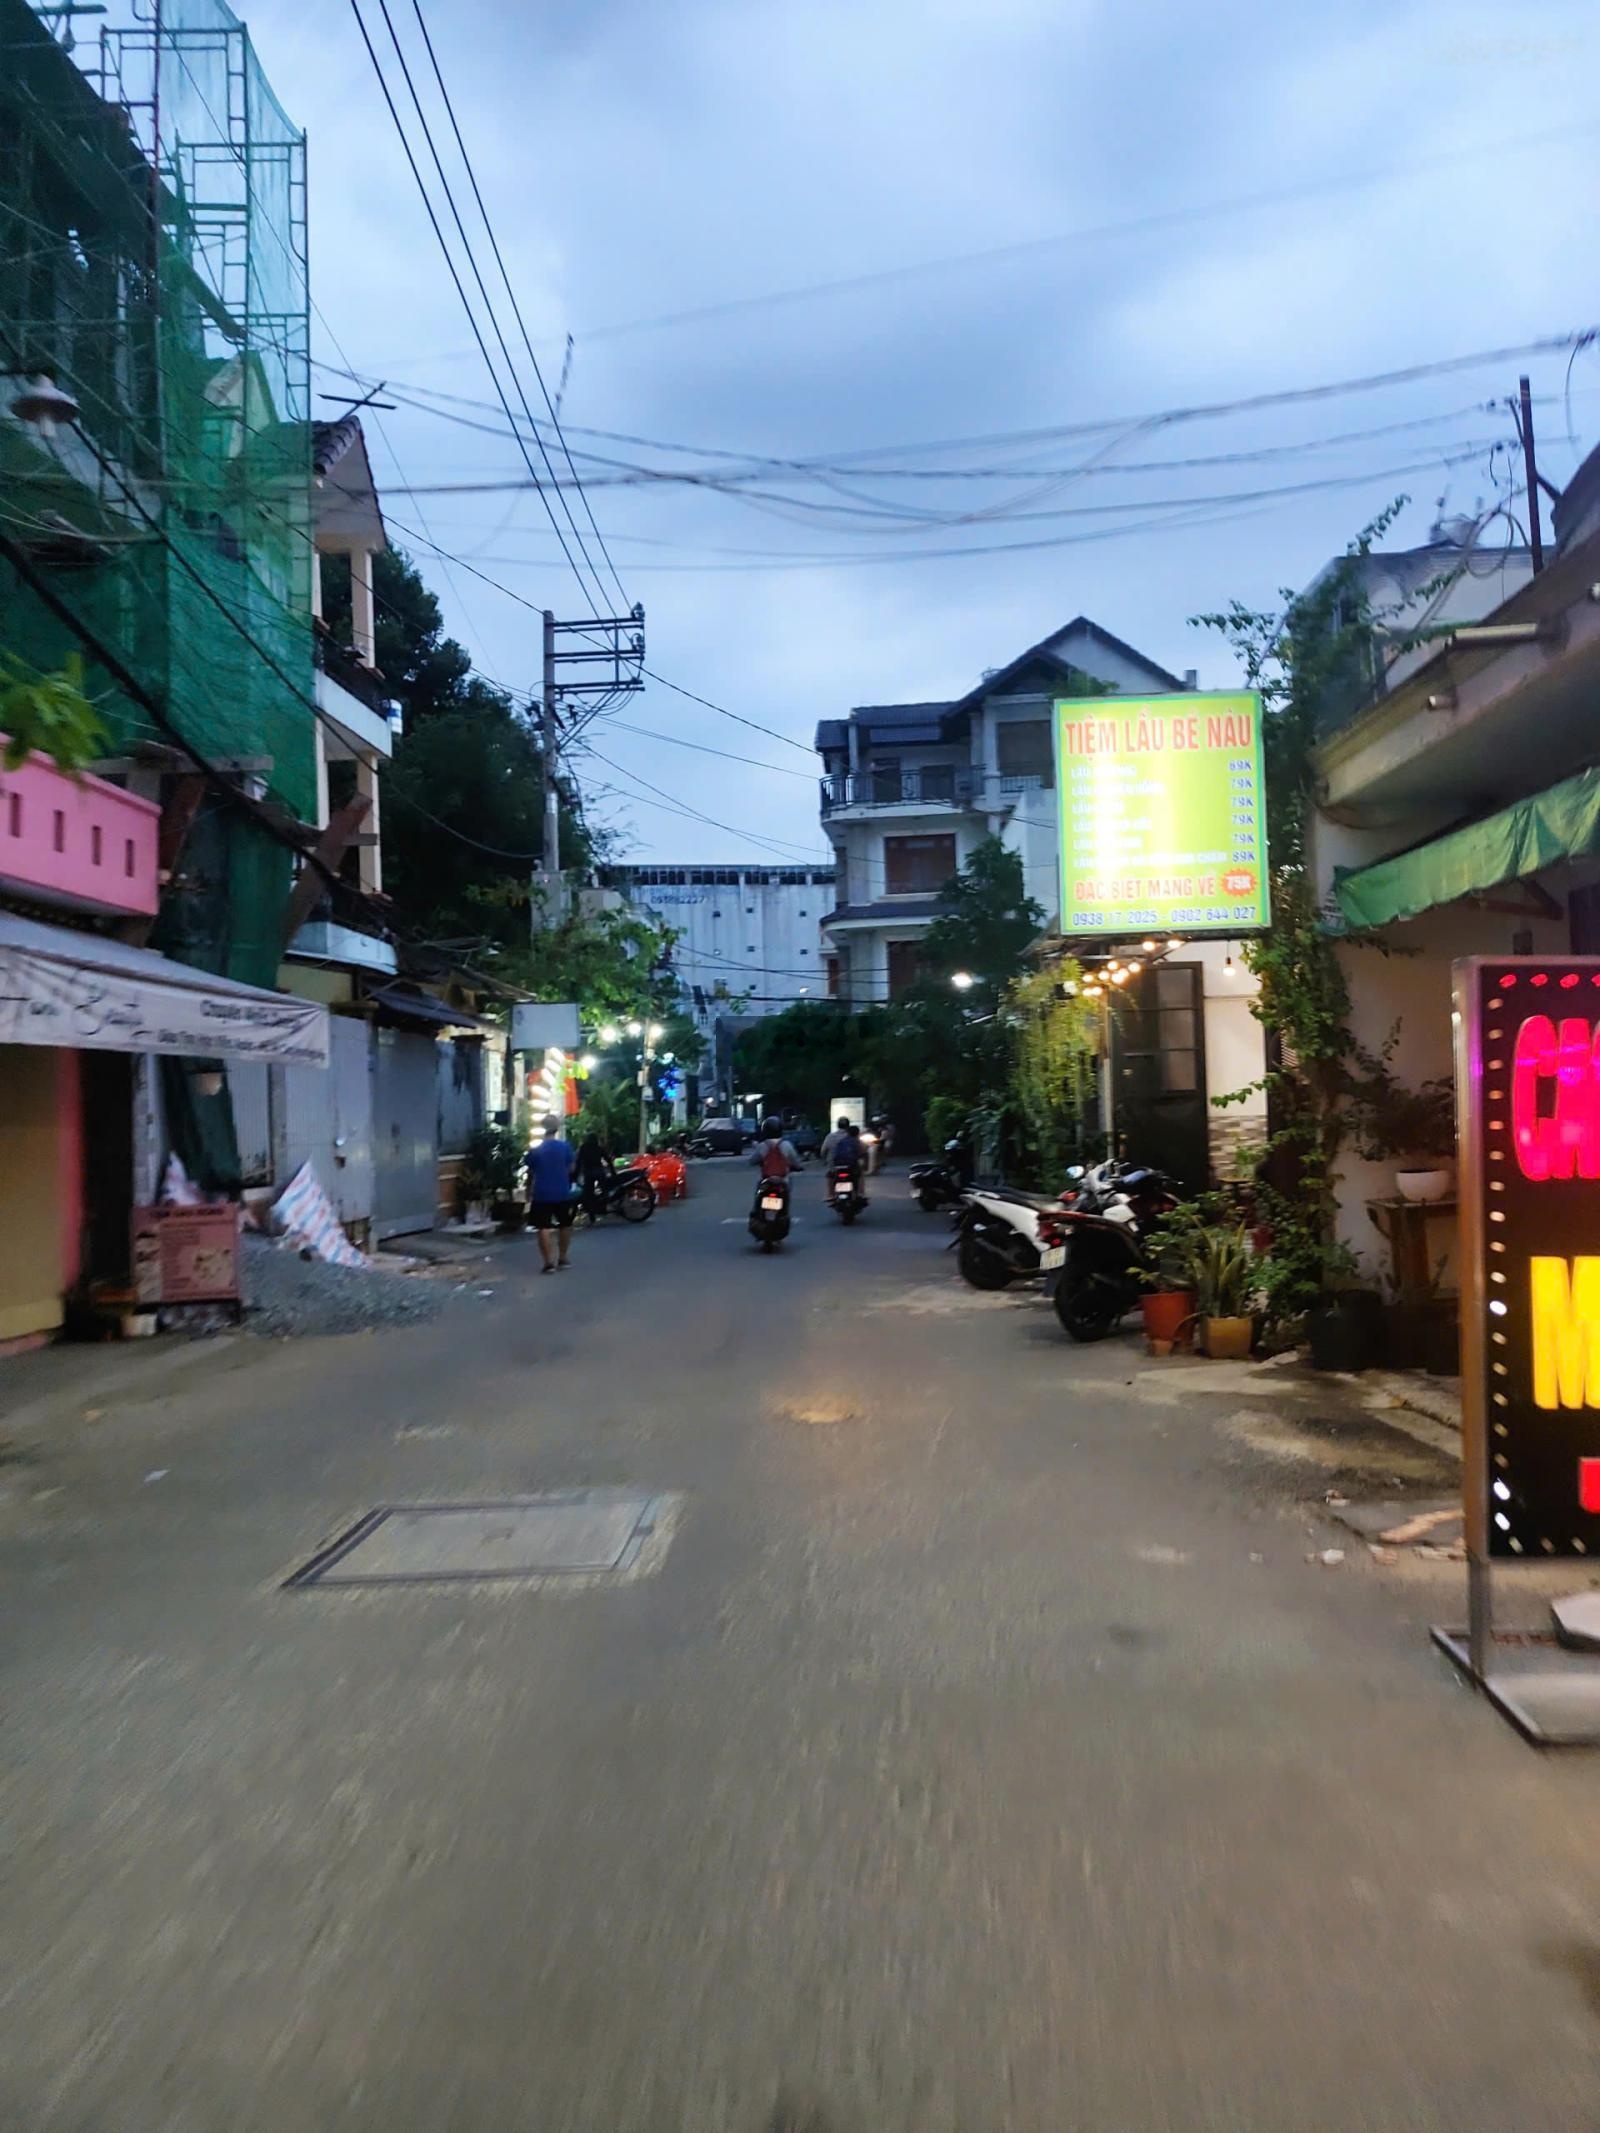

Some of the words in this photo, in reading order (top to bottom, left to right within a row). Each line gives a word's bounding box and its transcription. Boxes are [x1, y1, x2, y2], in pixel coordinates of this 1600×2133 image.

[1065, 714, 1117, 761] TIỆM
[1073, 912, 1103, 926] 0938
[1233, 906, 1256, 919] 027
